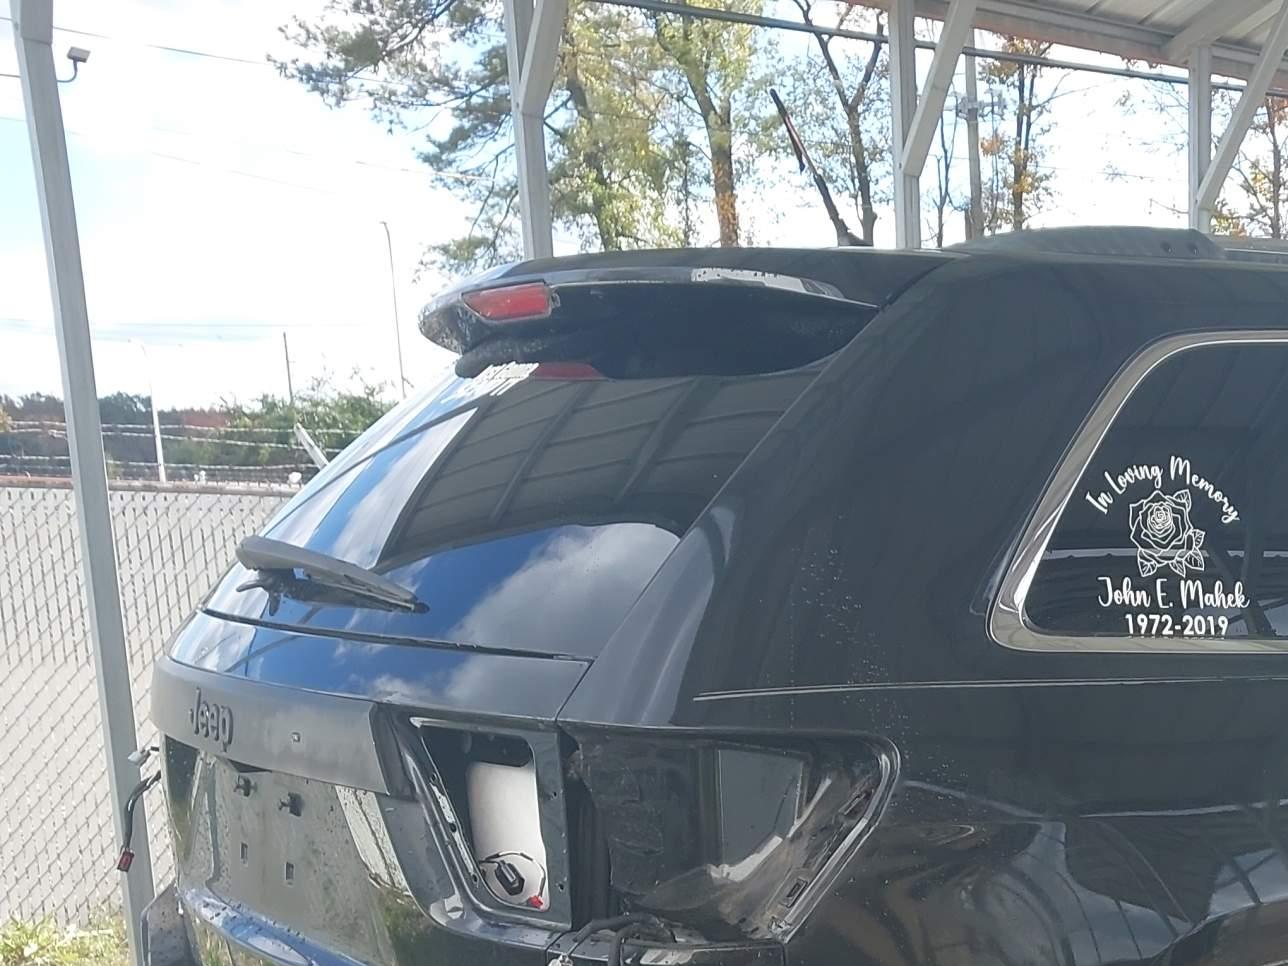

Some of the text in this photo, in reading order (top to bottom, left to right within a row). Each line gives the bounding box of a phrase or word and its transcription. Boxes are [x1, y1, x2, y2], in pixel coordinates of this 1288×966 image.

[1085, 455, 1240, 524] In Loving Memory
[1097, 576, 1250, 609] John E. Mahek
[1125, 614, 1229, 636] 1972-2019
[188, 687, 234, 752] Jeep
